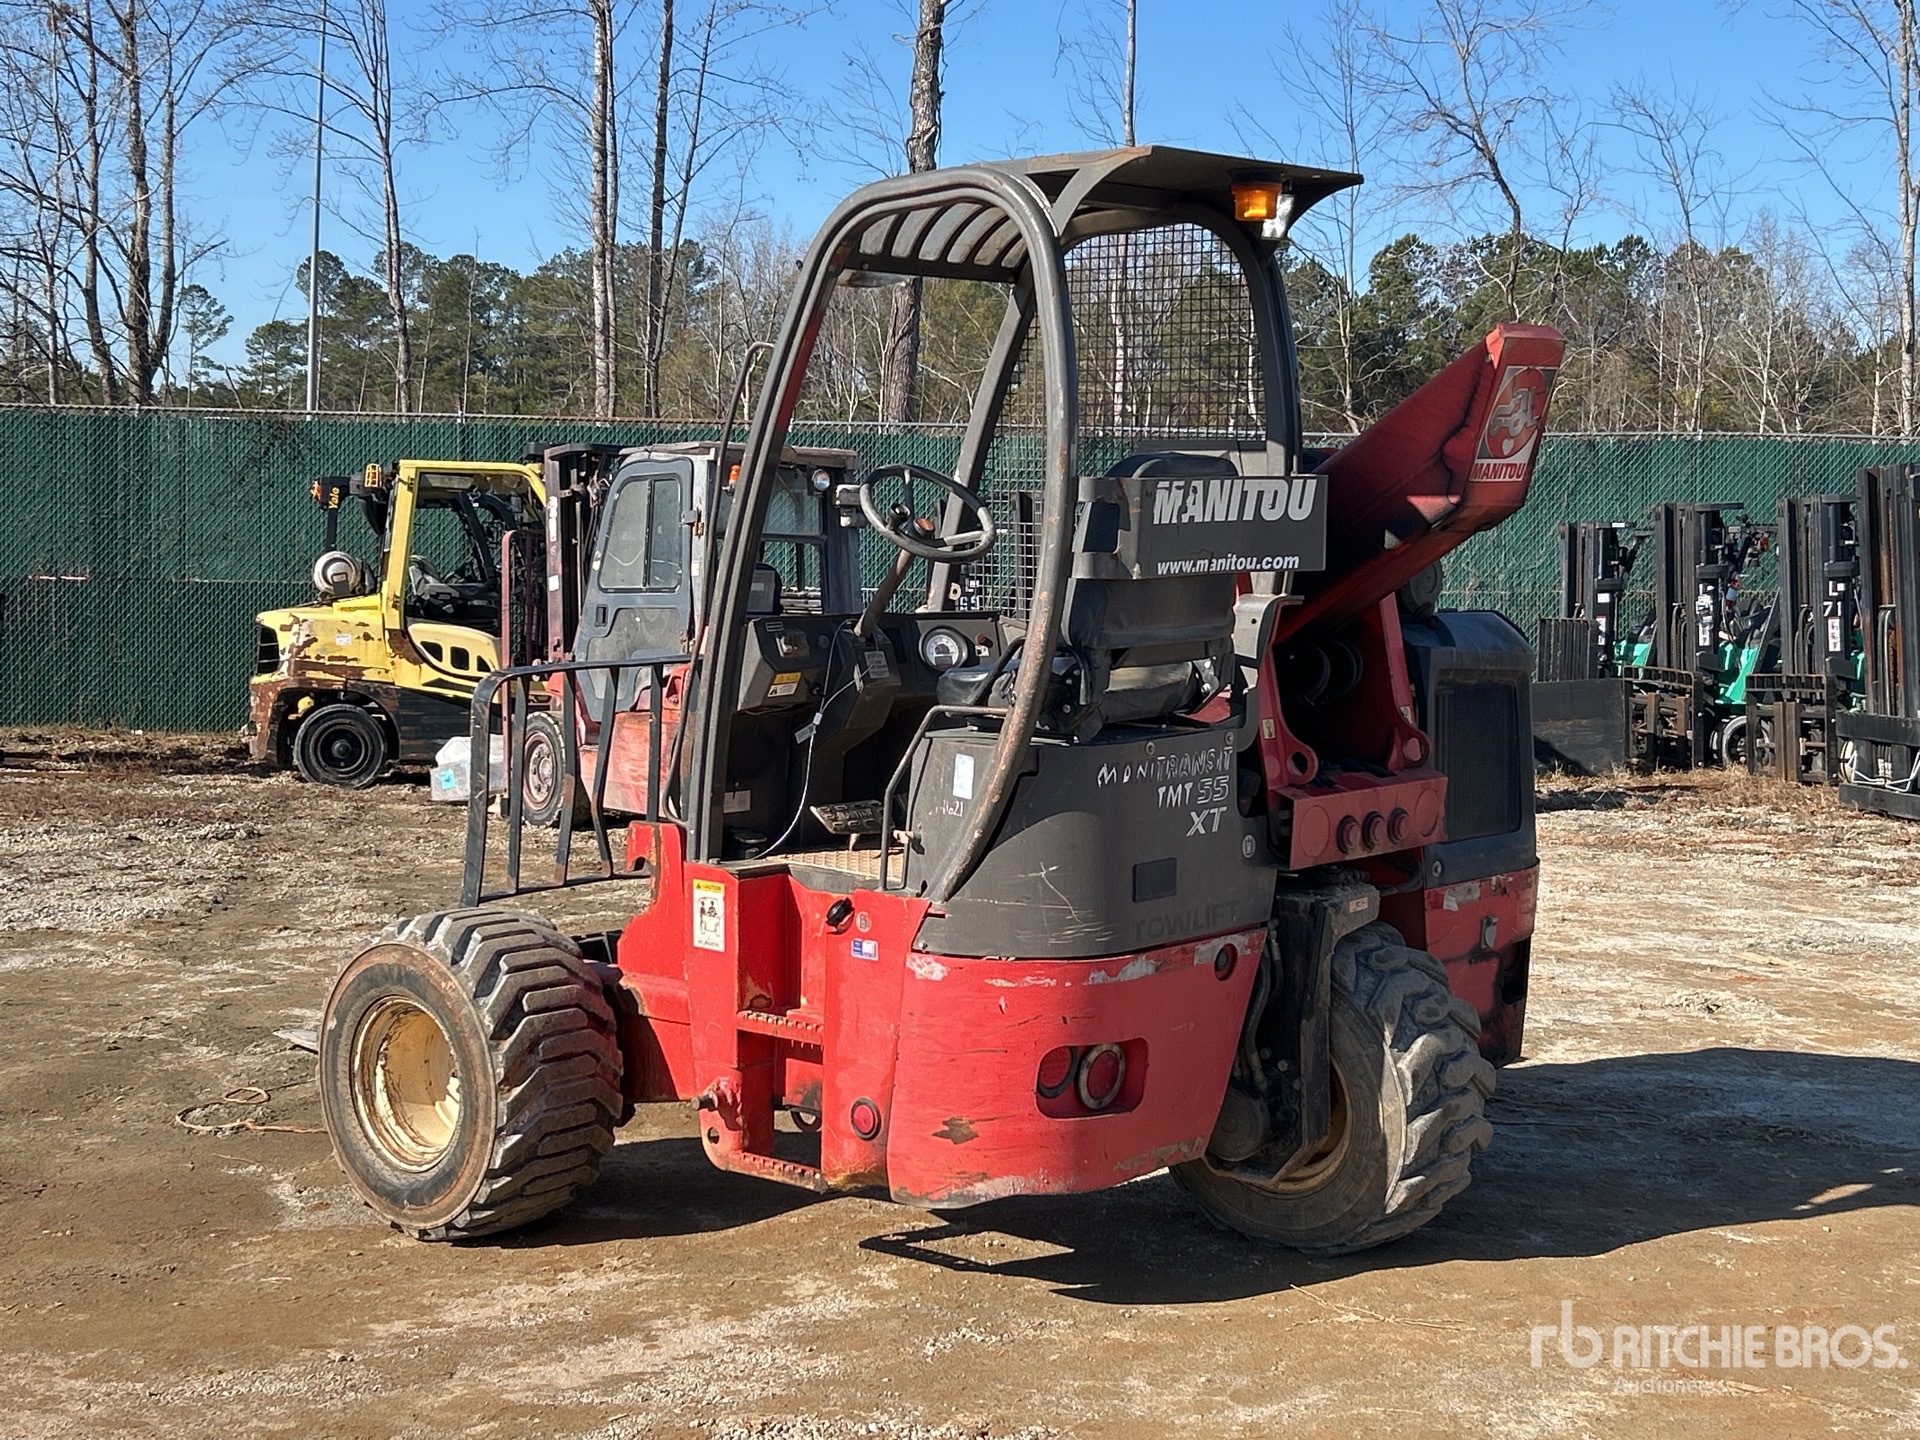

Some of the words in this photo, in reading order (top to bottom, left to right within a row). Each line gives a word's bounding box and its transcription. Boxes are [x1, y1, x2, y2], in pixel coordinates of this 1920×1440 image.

[1470, 463, 1527, 480] MANITOU
[1153, 479, 1318, 525] MANITOU
[1157, 553, 1300, 575] www.manitou.com
[1157, 782, 1194, 808] TMT
[1197, 775, 1230, 804] 55
[1186, 806, 1228, 837] XT
